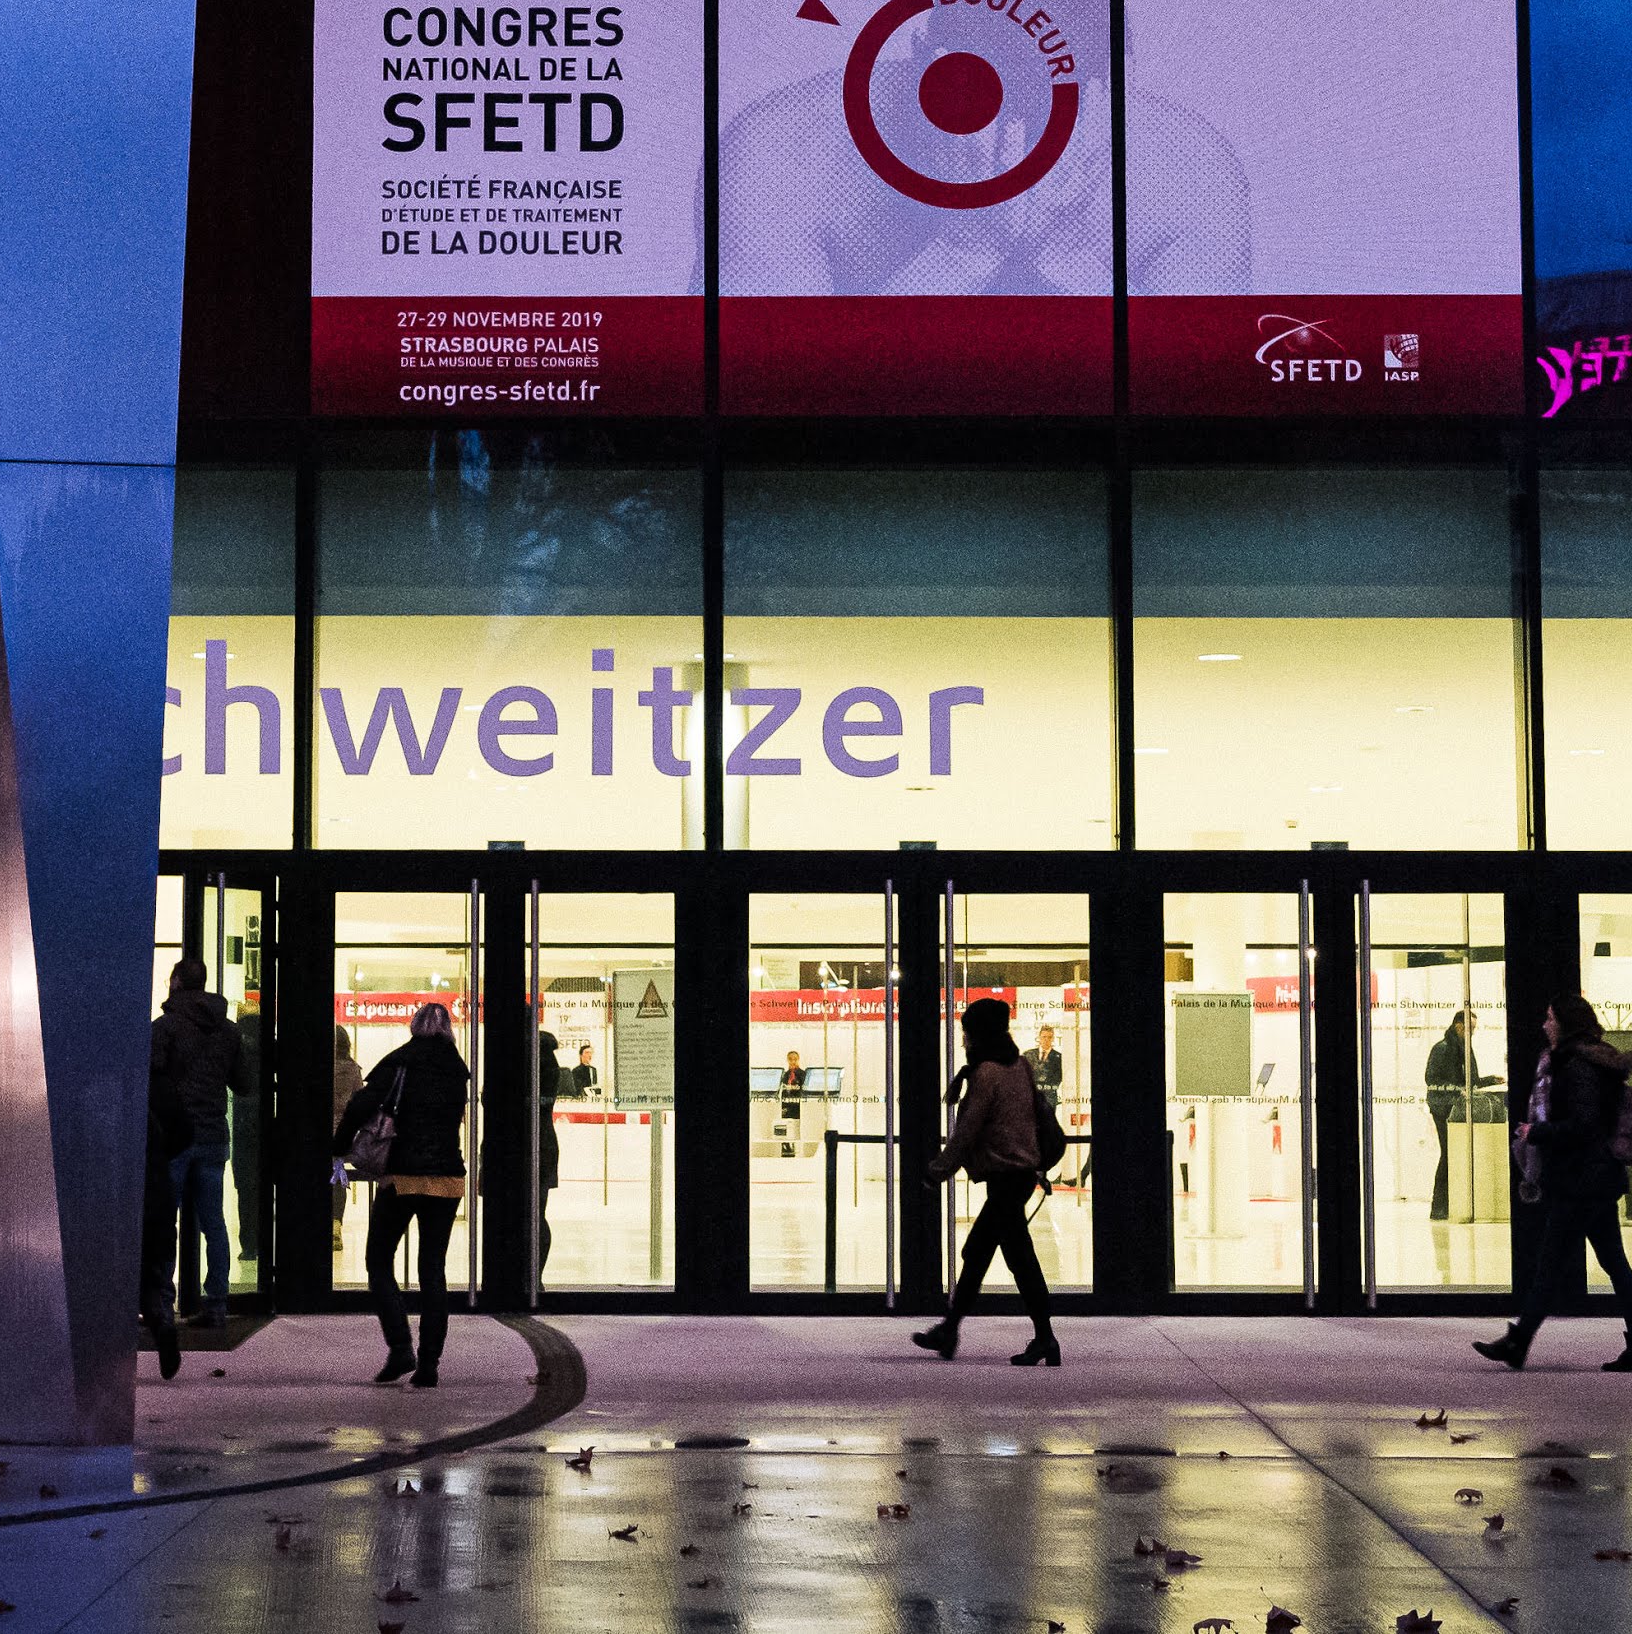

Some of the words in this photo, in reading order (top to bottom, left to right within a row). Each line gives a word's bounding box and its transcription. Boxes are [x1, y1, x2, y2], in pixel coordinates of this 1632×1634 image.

[383, 6, 624, 48] CONGRES
[382, 57, 530, 82] NATIONAL
[539, 57, 577, 82] DE
[586, 57, 624, 81] LA
[381, 92, 625, 153] SFETD
[381, 173, 481, 200] SOCIÉTÉ
[488, 179, 622, 204] FRANÇAISE
[381, 204, 455, 223] D'ÉTUDE
[460, 208, 481, 223] ET
[485, 208, 507, 223] DE
[512, 208, 623, 223] TRAITEMENT
[381, 230, 420, 255] DE
[430, 230, 469, 255] LA
[478, 230, 623, 256] DOULEUR
[397, 311, 447, 327] 27-29
[453, 311, 556, 328] NOVEMBRE
[561, 311, 603, 327] 2019
[400, 336, 528, 353] STRASBOURG
[534, 337, 599, 353] PALAIS
[400, 356, 416, 368] DE
[420, 357, 435, 368] LA
[438, 356, 493, 367] MUSIQUE
[497, 356, 511, 368] ET
[514, 356, 538, 368] DES
[541, 354, 599, 368] CONGRÈS
[1270, 359, 1362, 382] SFETD
[1384, 365, 1419, 382] IASP
[399, 379, 601, 406] congres-sfetd.fr
[564, 1000, 577, 1009] de
[579, 1000, 588, 1009] la
[1171, 999, 1200, 1009] Palais
[1203, 999, 1216, 1009] de
[1218, 999, 1228, 1009] la
[1230, 999, 1274, 1011] Musique
[1399, 1000, 1457, 1010] Schweitzer
